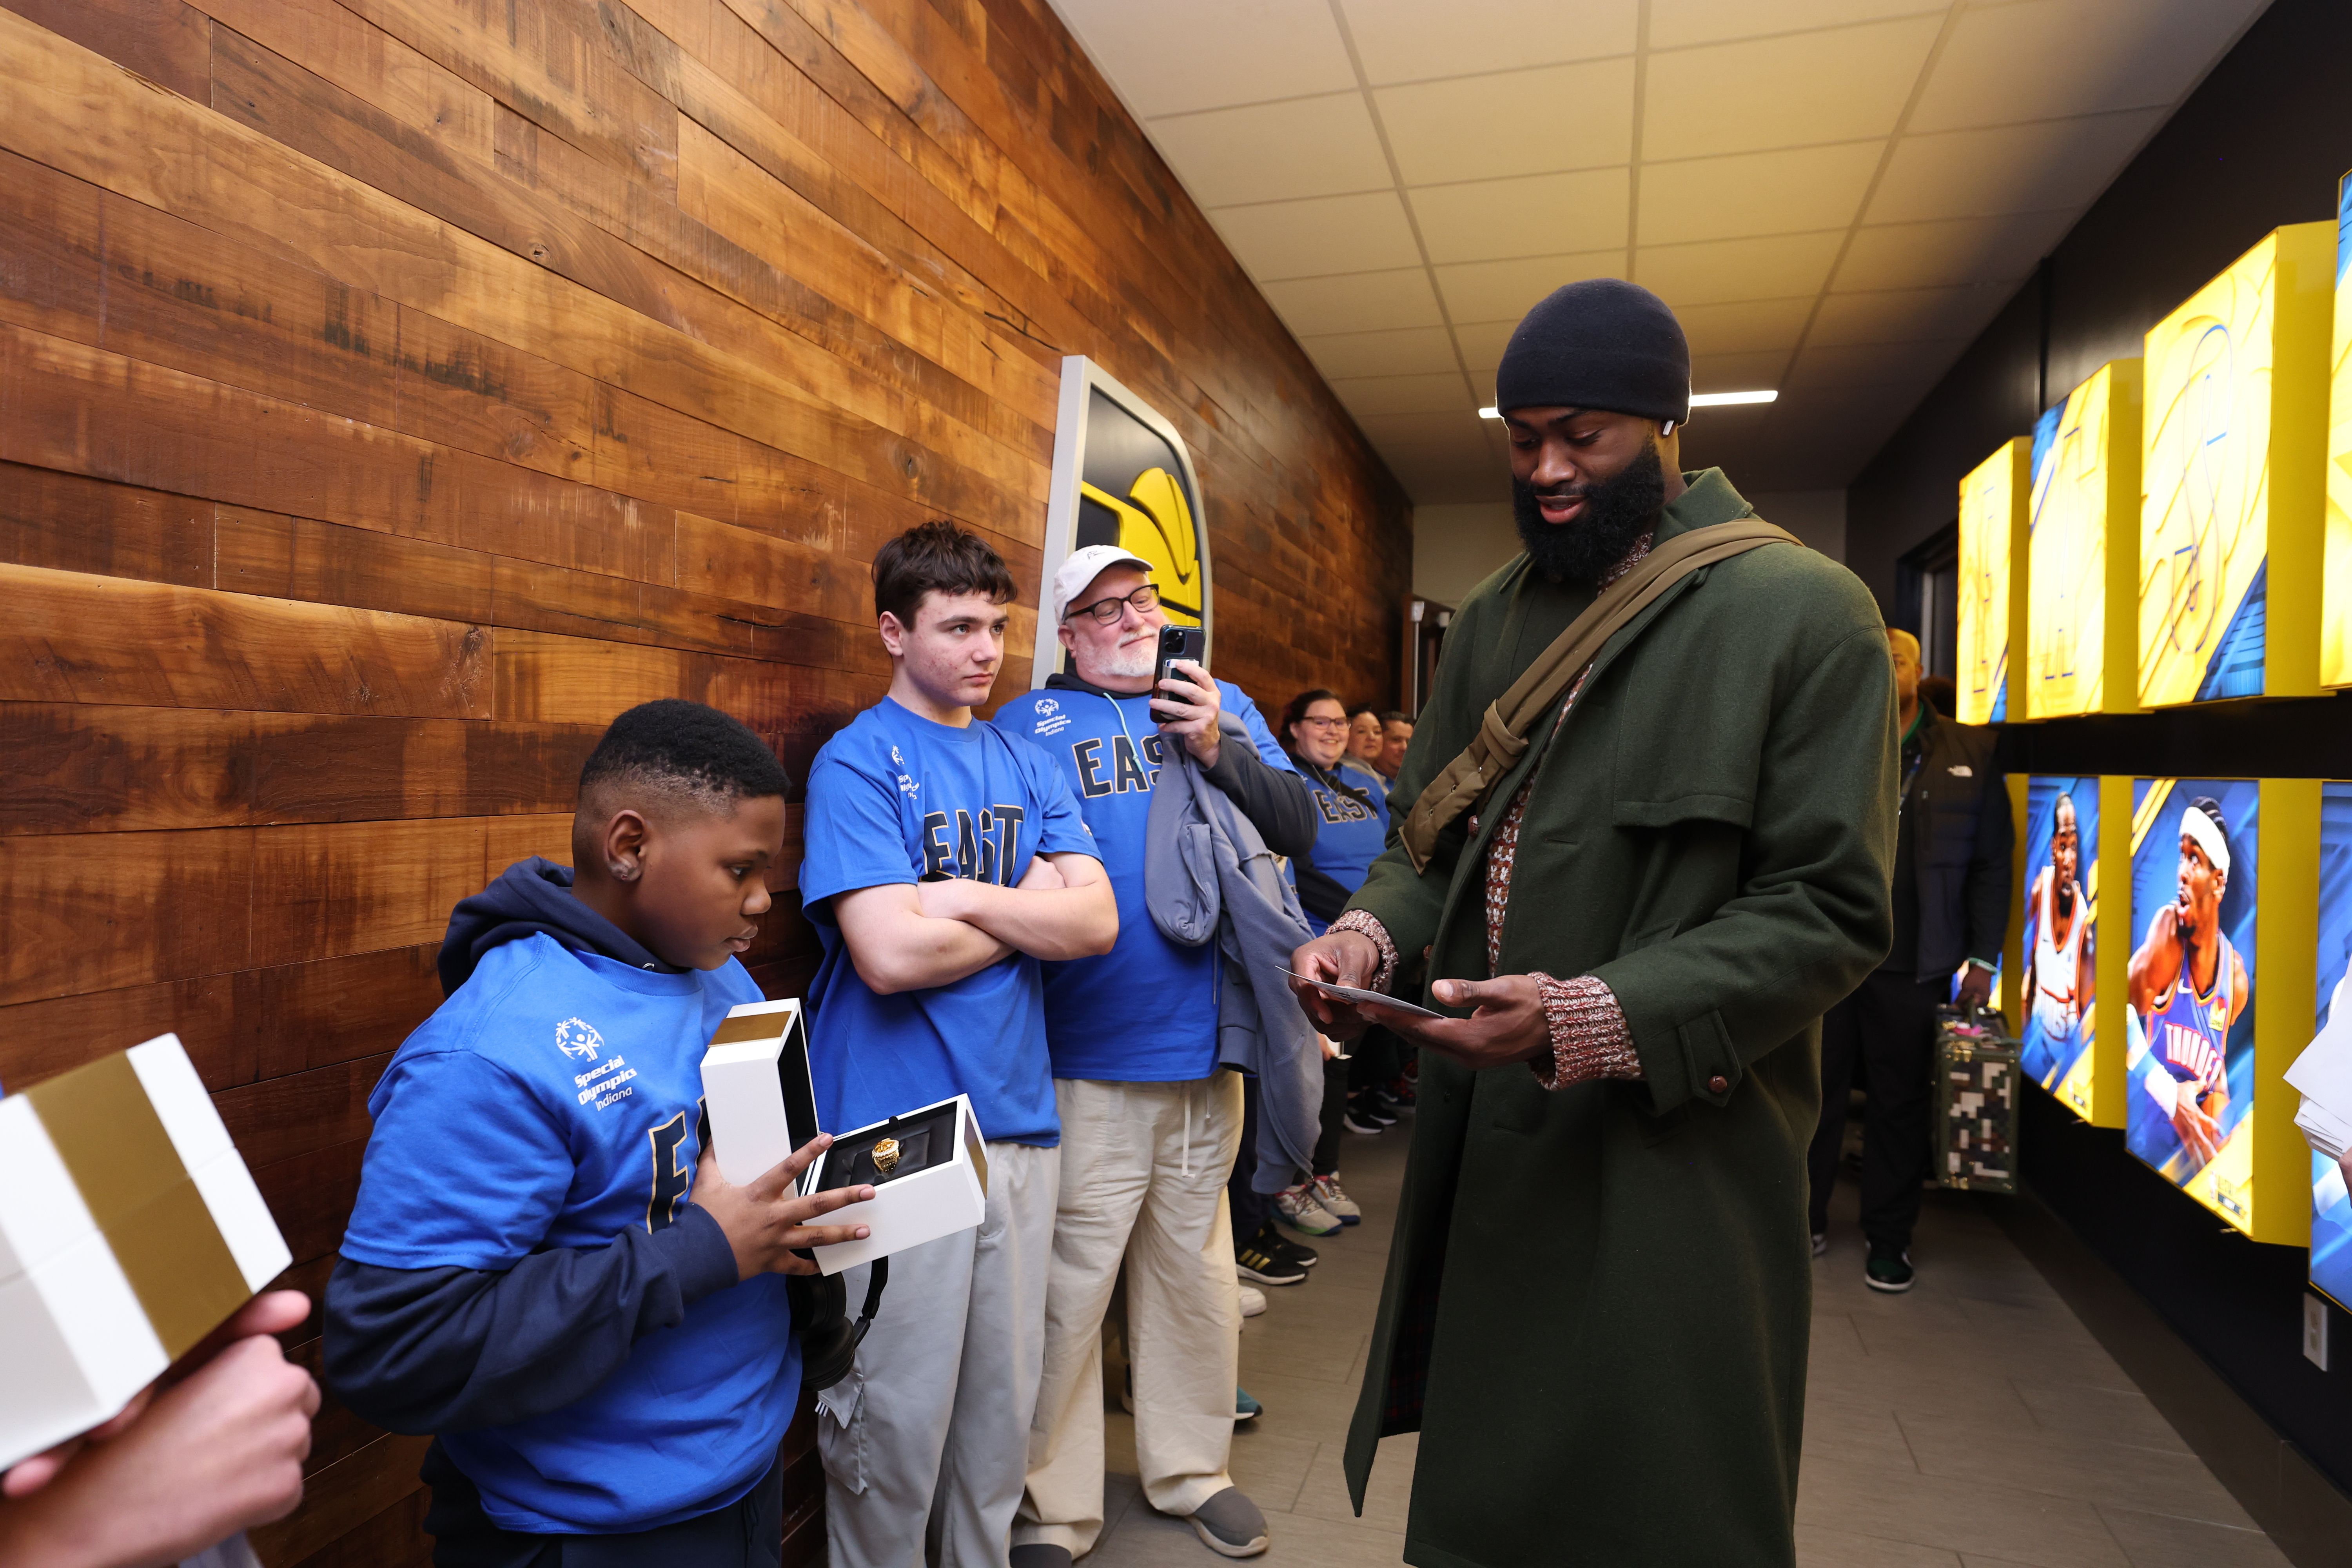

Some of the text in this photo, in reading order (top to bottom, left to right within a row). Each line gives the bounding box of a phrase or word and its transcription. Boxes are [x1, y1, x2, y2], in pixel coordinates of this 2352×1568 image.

[1035, 719, 1071, 734] Olympics
[1036, 714, 1066, 727] Special
[1045, 726, 1064, 736] Indiana
[1071, 734, 1163, 799] EAS
[2164, 1020, 2223, 1091] THUNDER
[574, 1055, 625, 1089] Special
[577, 1068, 637, 1105] Olympics
[595, 1087, 633, 1112] Indiana
